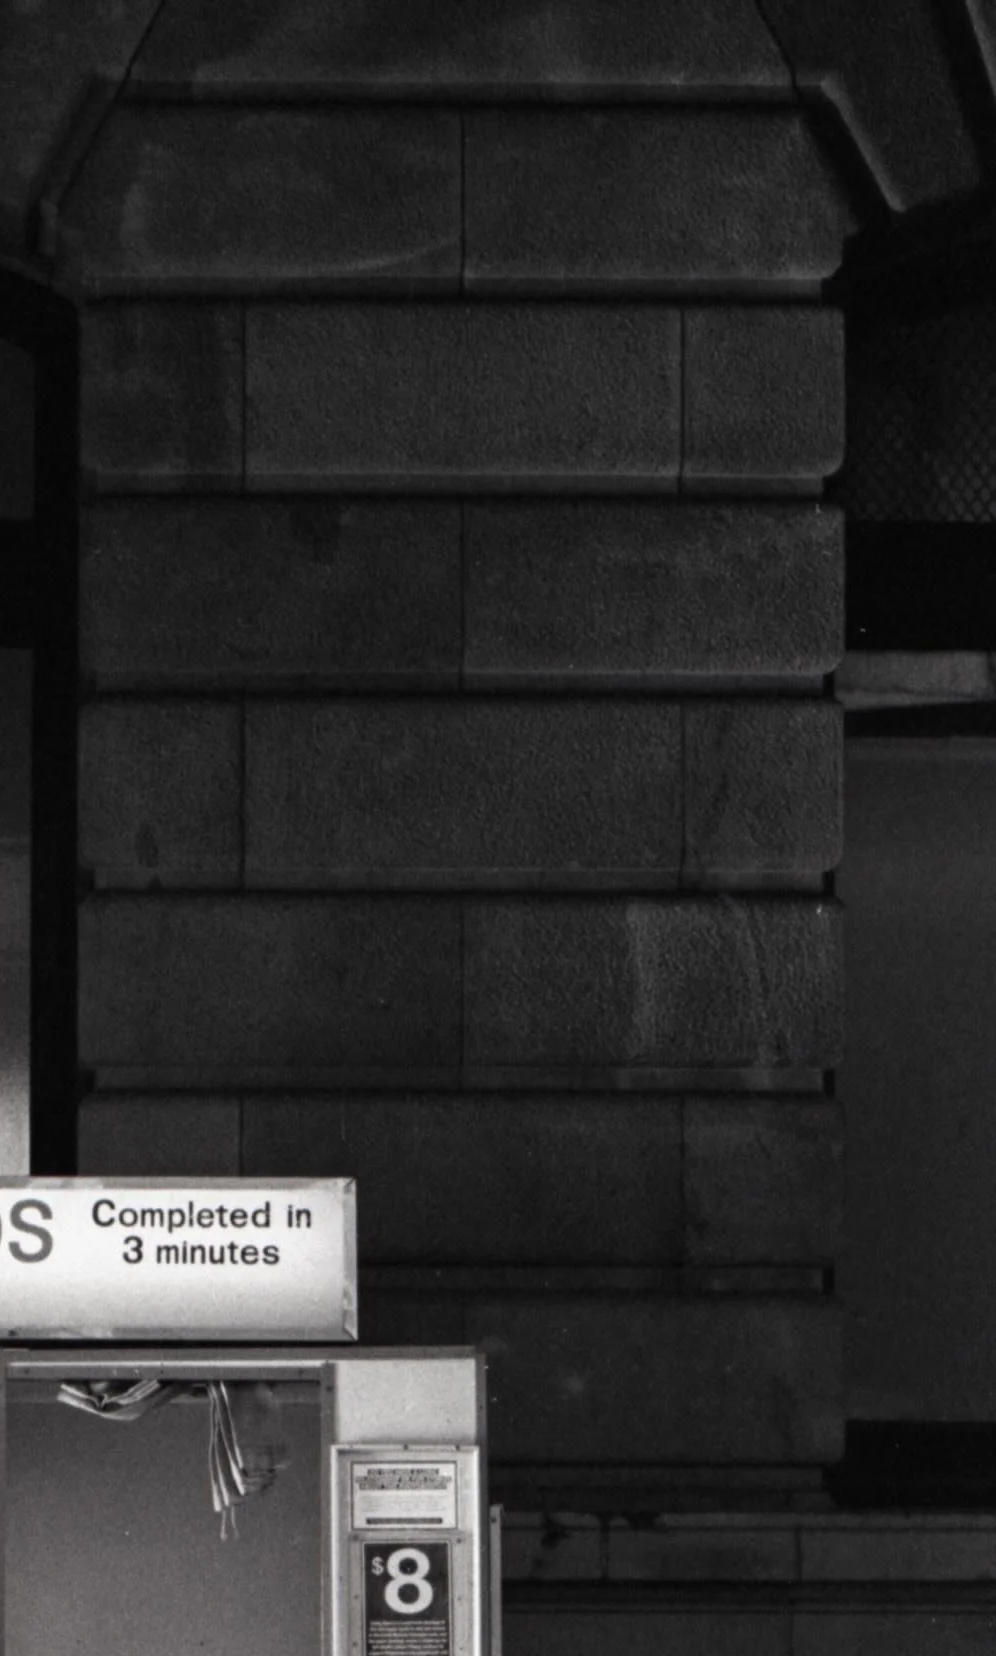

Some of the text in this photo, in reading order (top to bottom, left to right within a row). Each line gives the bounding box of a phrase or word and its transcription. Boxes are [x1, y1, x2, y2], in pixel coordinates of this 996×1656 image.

[92, 1200, 313, 1231] Completed in
[123, 1236, 280, 1264] 3 minutes
[371, 1547, 433, 1615] $8
